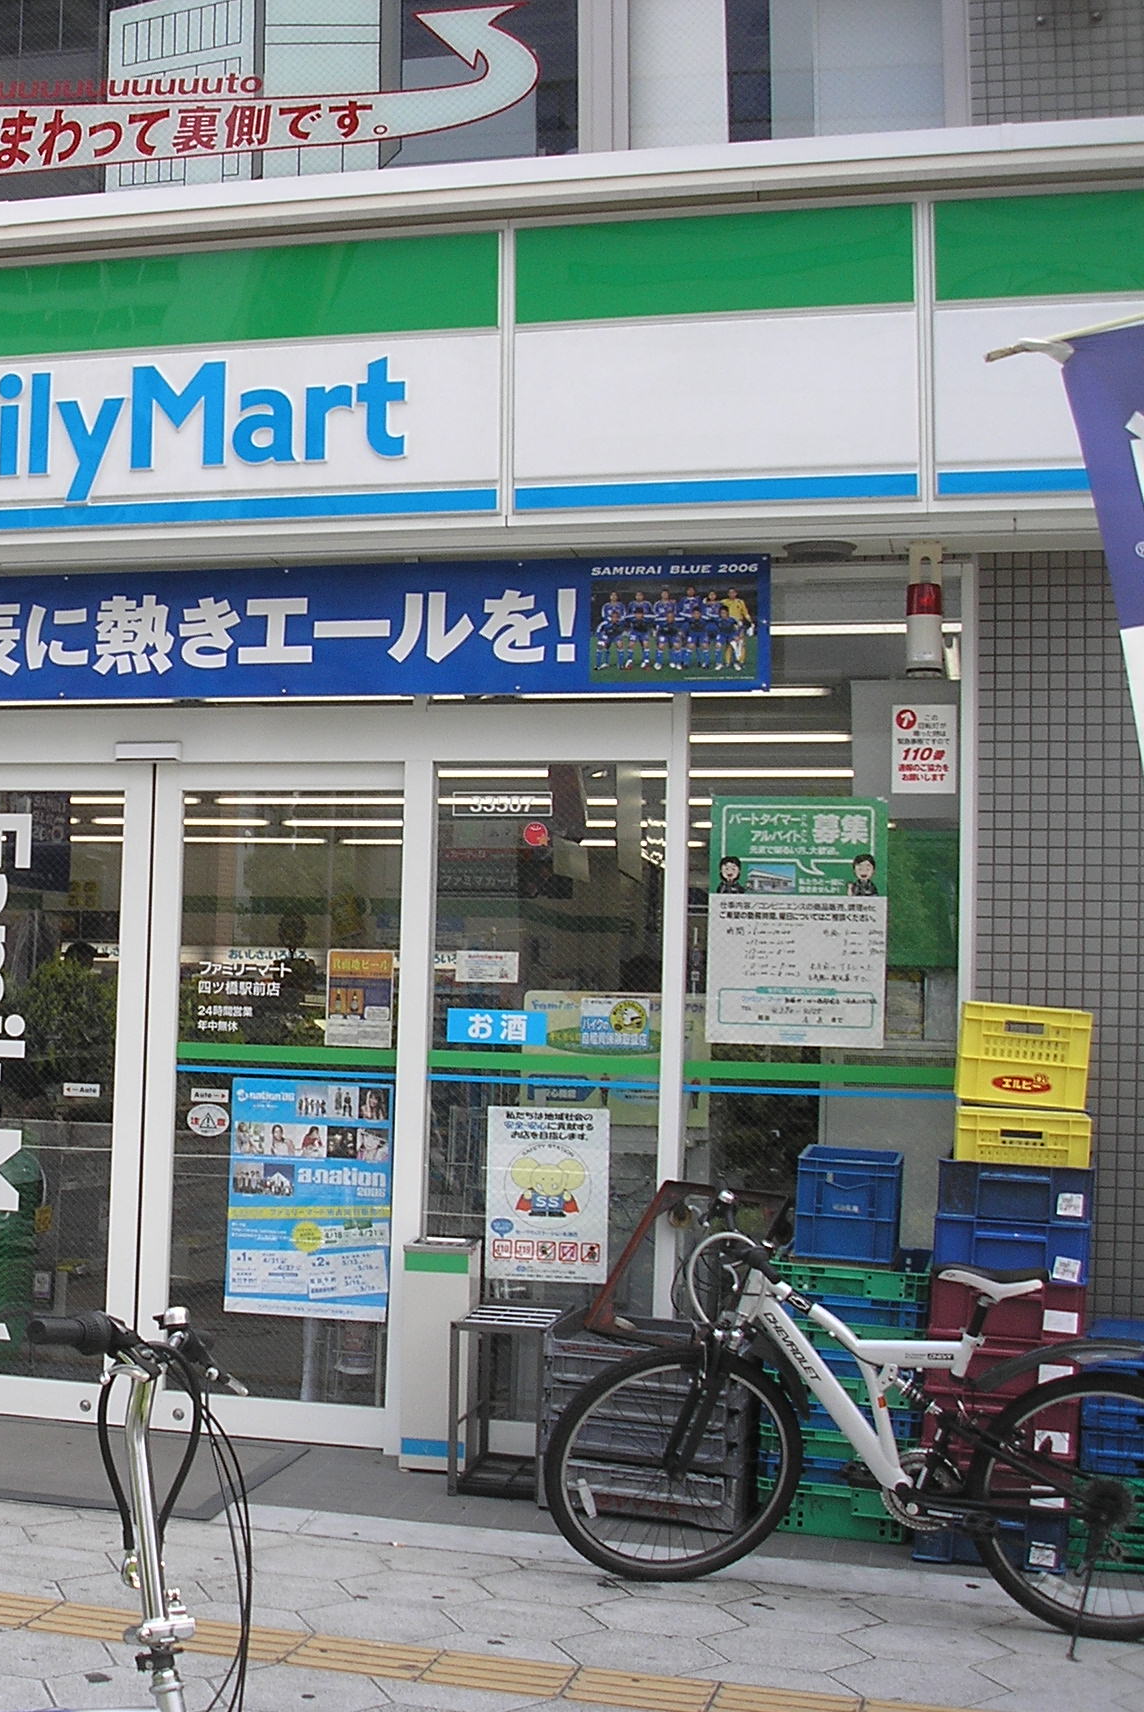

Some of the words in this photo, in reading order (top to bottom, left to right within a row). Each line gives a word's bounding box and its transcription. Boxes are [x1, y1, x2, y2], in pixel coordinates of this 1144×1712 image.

[591, 565, 662, 576] SAMURAI
[670, 564, 712, 575] BLUE
[718, 563, 758, 574] 2006
[812, 813, 870, 845] 募集
[199, 961, 292, 978] ファミリーマート
[197, 980, 281, 997] 四ツ橋駅前店
[197, 1005, 253, 1017] 24時間営業
[197, 1020, 239, 1032] 年中無休
[467, 1013, 528, 1042] お酒
[535, 1195, 561, 1208] SS
[764, 1312, 822, 1381] CHEVROLET
